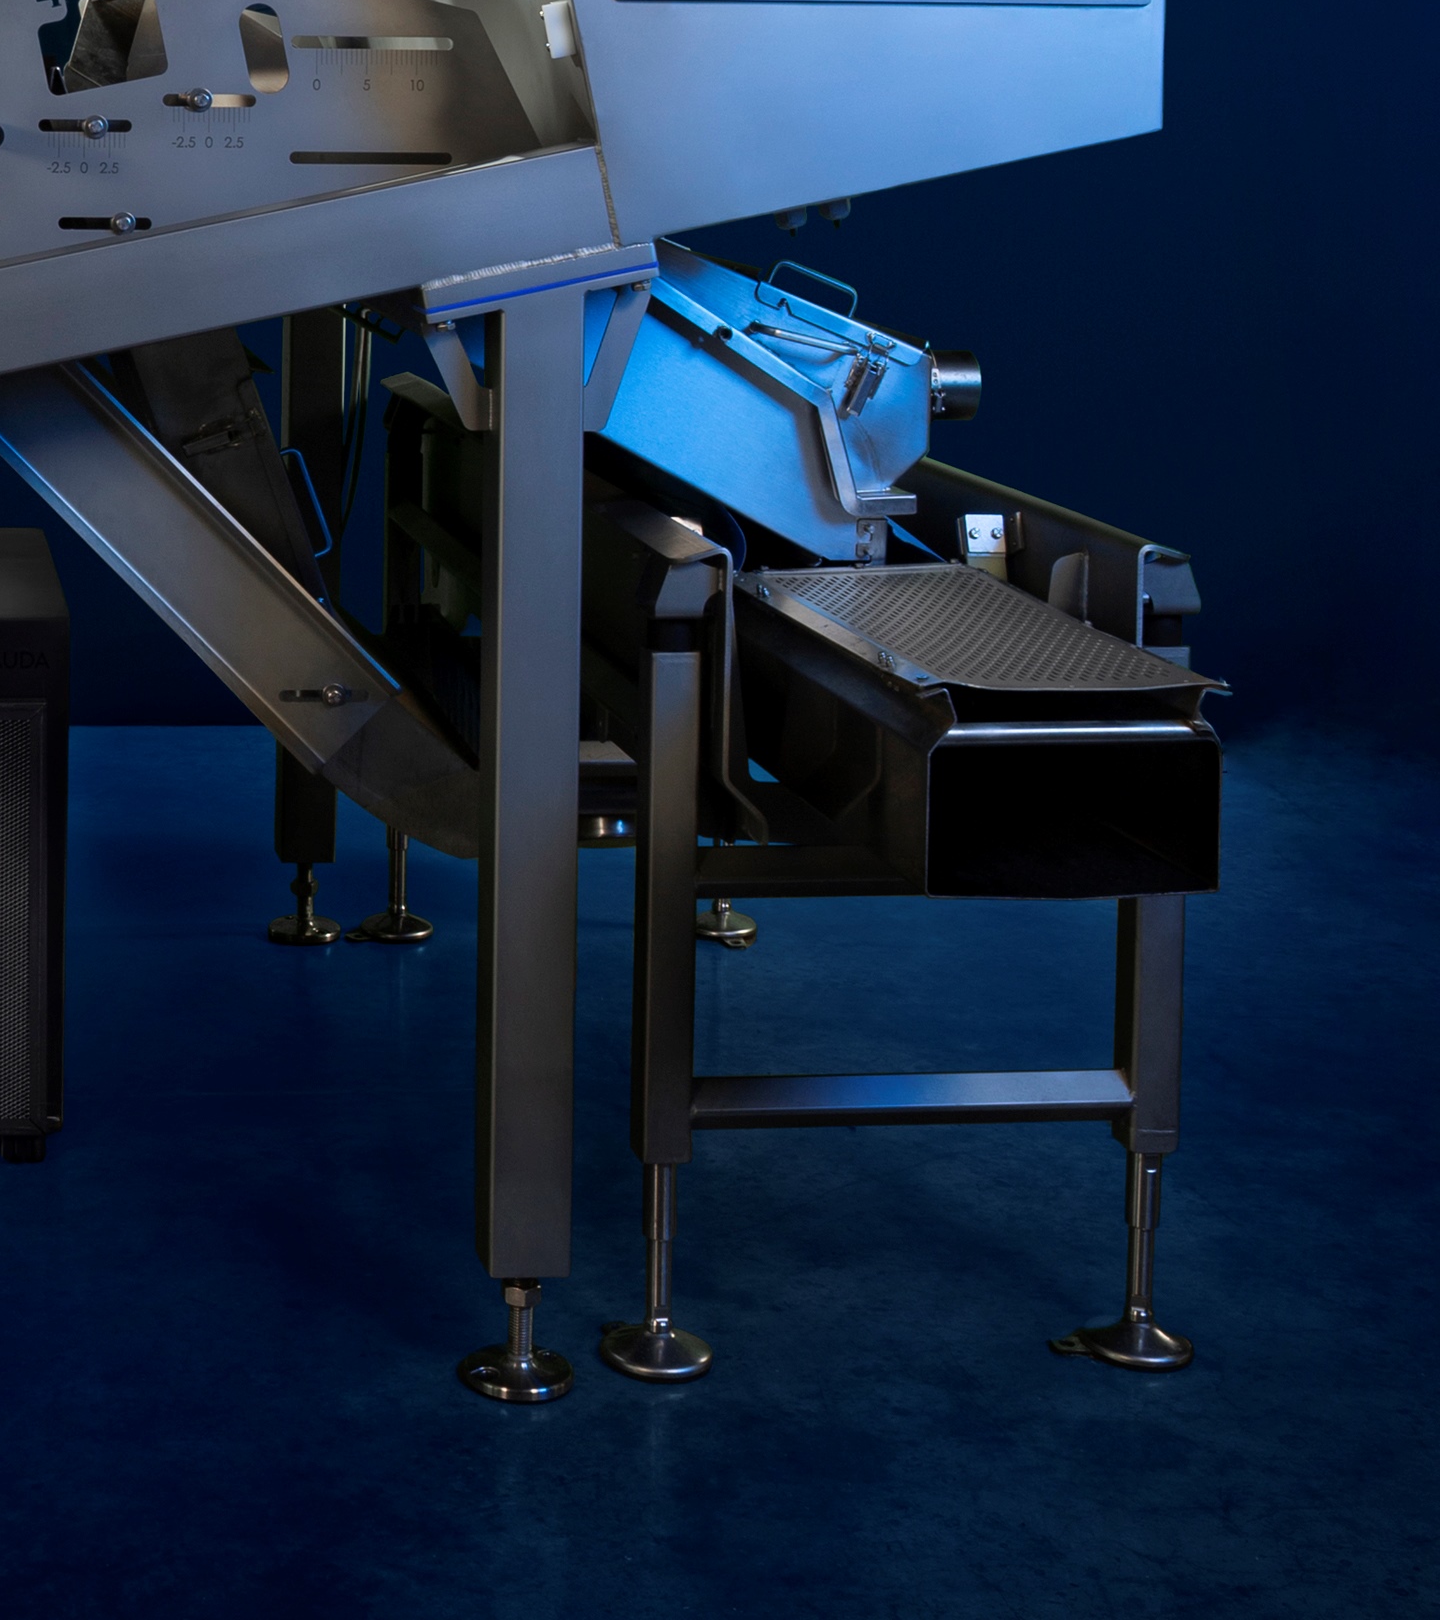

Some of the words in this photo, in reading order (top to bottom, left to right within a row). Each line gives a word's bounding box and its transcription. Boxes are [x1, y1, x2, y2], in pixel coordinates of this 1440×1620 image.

[312, 78, 321, 91] 0
[363, 78, 371, 91] 5
[410, 78, 425, 92] 10
[171, 136, 196, 149] -2.5
[205, 136, 213, 149] 0
[224, 136, 244, 149] 2.5
[46, 161, 71, 174] -2.5
[80, 161, 88, 174] 0
[99, 161, 119, 174] 2.5
